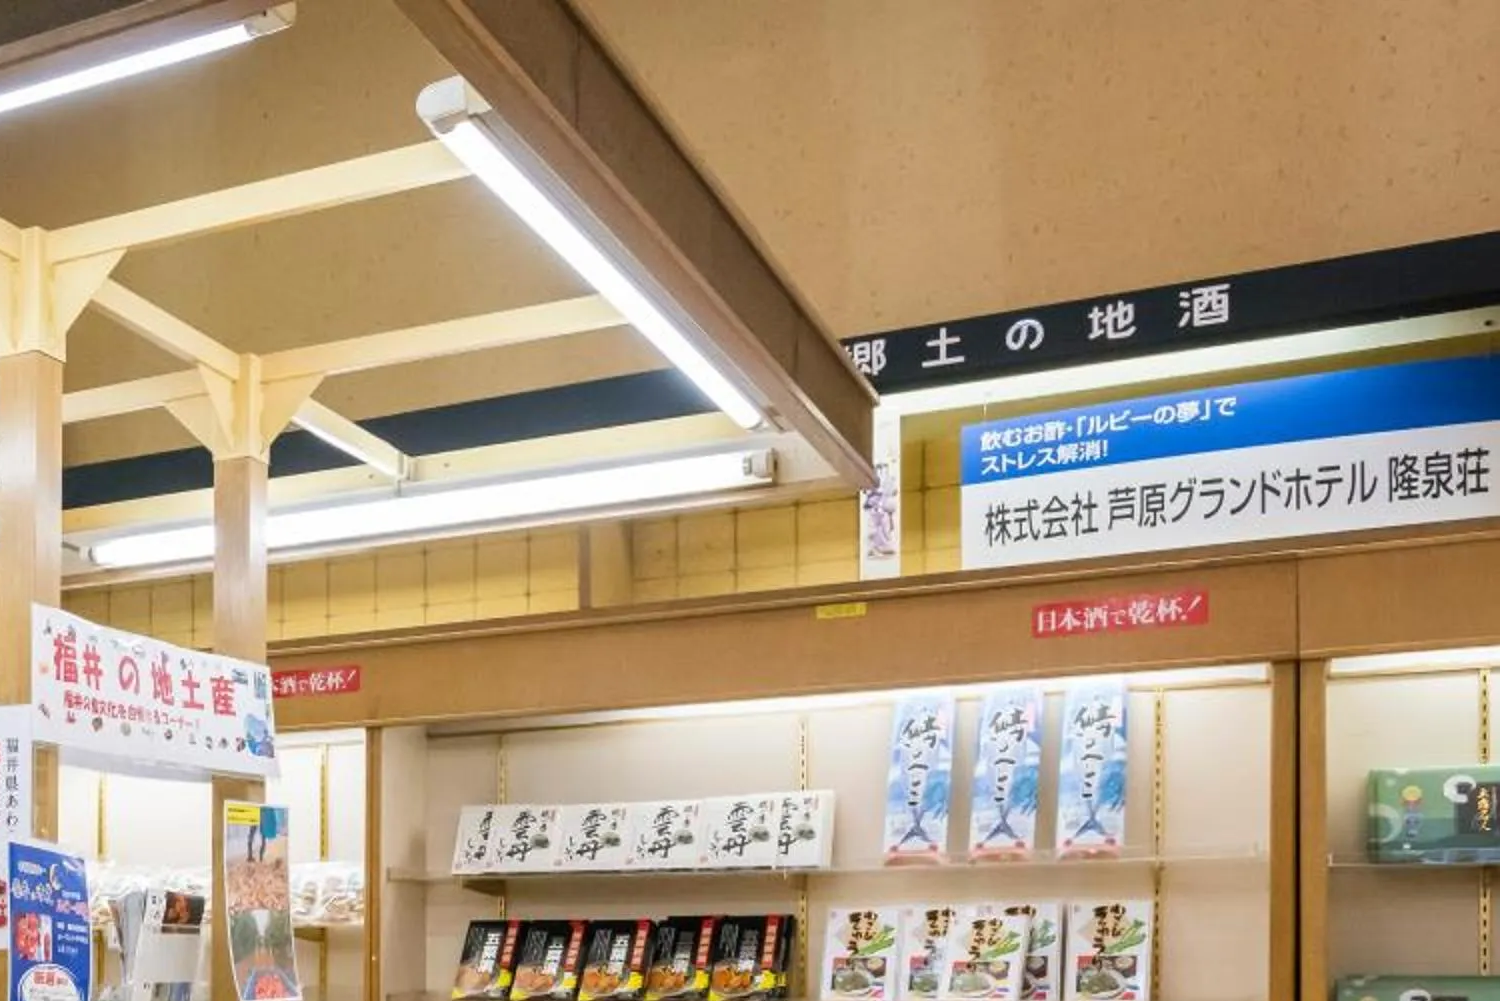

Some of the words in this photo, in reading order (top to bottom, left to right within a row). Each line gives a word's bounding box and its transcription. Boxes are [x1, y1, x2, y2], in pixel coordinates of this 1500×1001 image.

[985, 496, 1099, 546] 株式会社
[1107, 461, 1378, 532] 芦原グランドホテル
[1387, 447, 1490, 501] 隆泉荘
[1035, 594, 1204, 634] 日本酒で乾杯!
[54, 630, 237, 717] 福井の地土産
[4, 737, 20, 834] 福井県あわ
